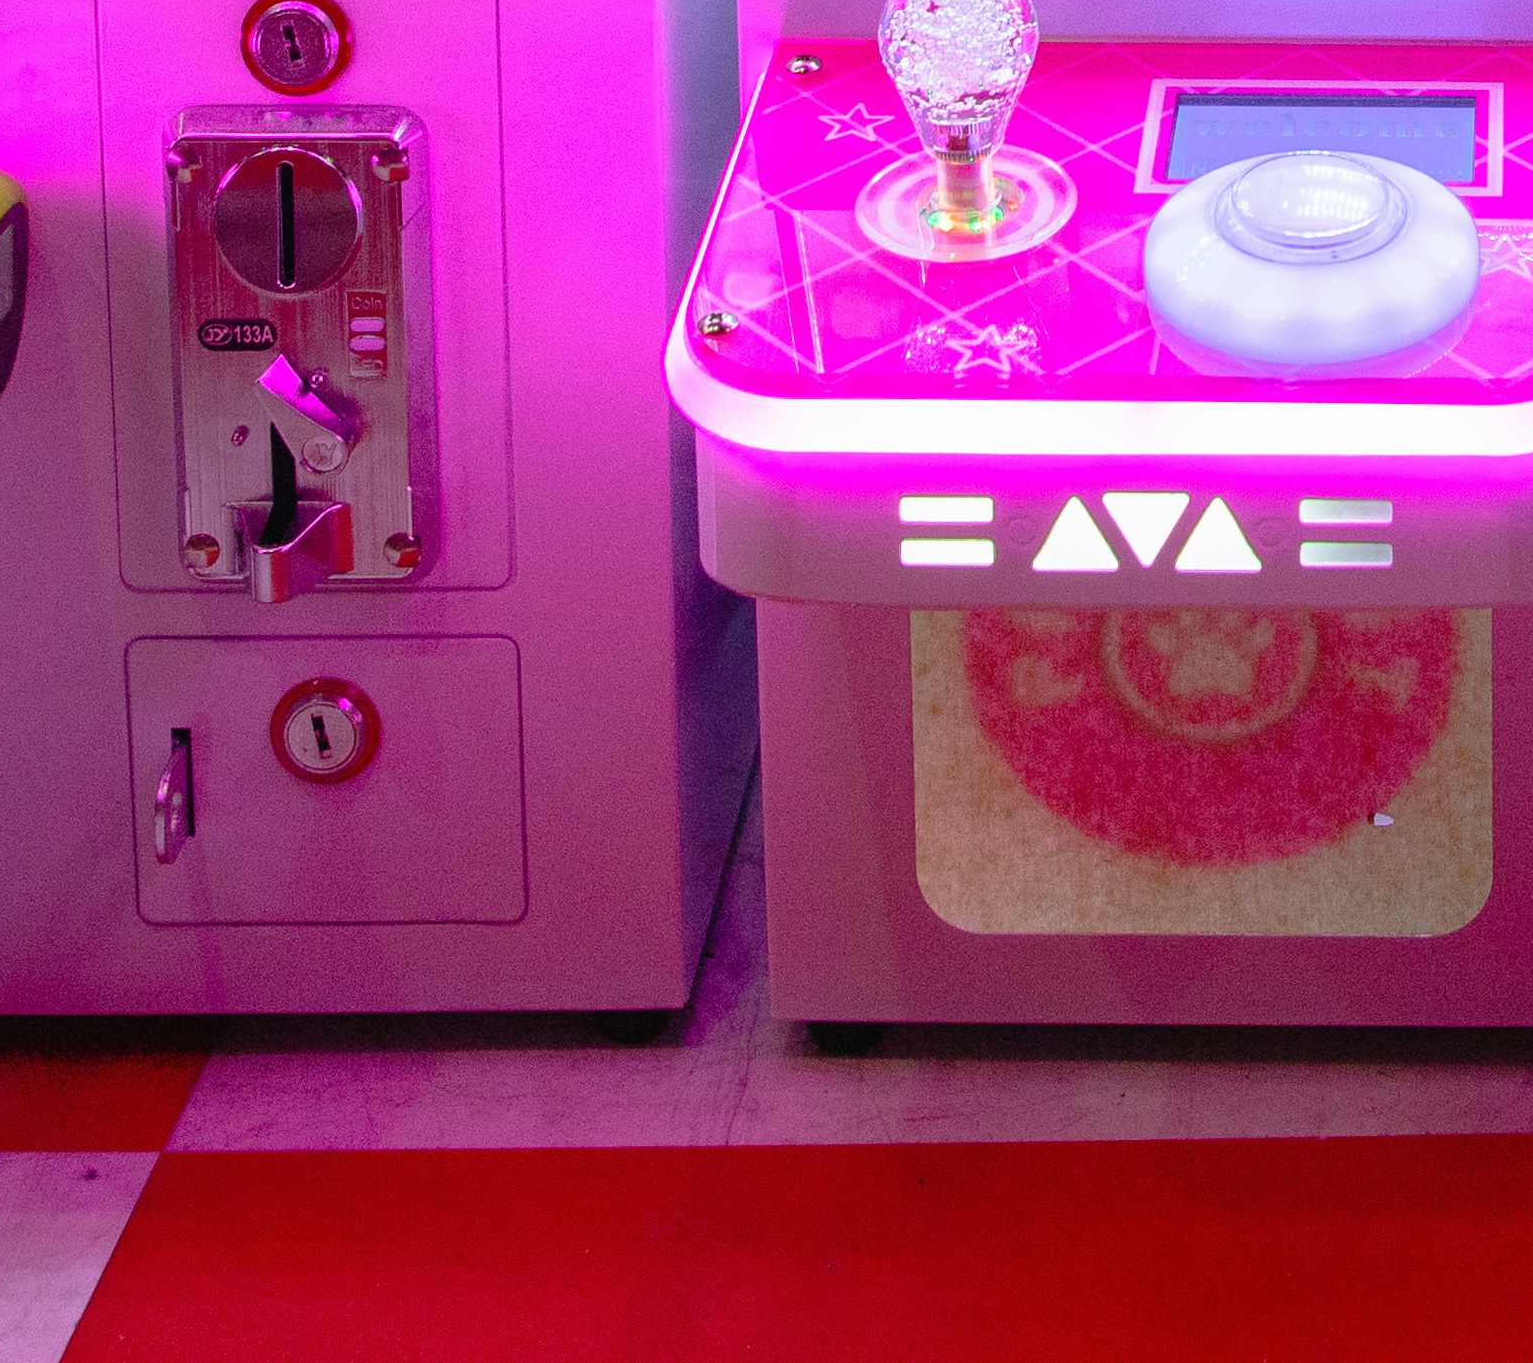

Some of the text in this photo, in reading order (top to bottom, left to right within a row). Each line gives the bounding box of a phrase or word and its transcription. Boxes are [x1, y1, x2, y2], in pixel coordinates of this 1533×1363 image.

[1193, 112, 1460, 139] welcome
[350, 296, 384, 312] Coin
[233, 325, 275, 344] 133A
